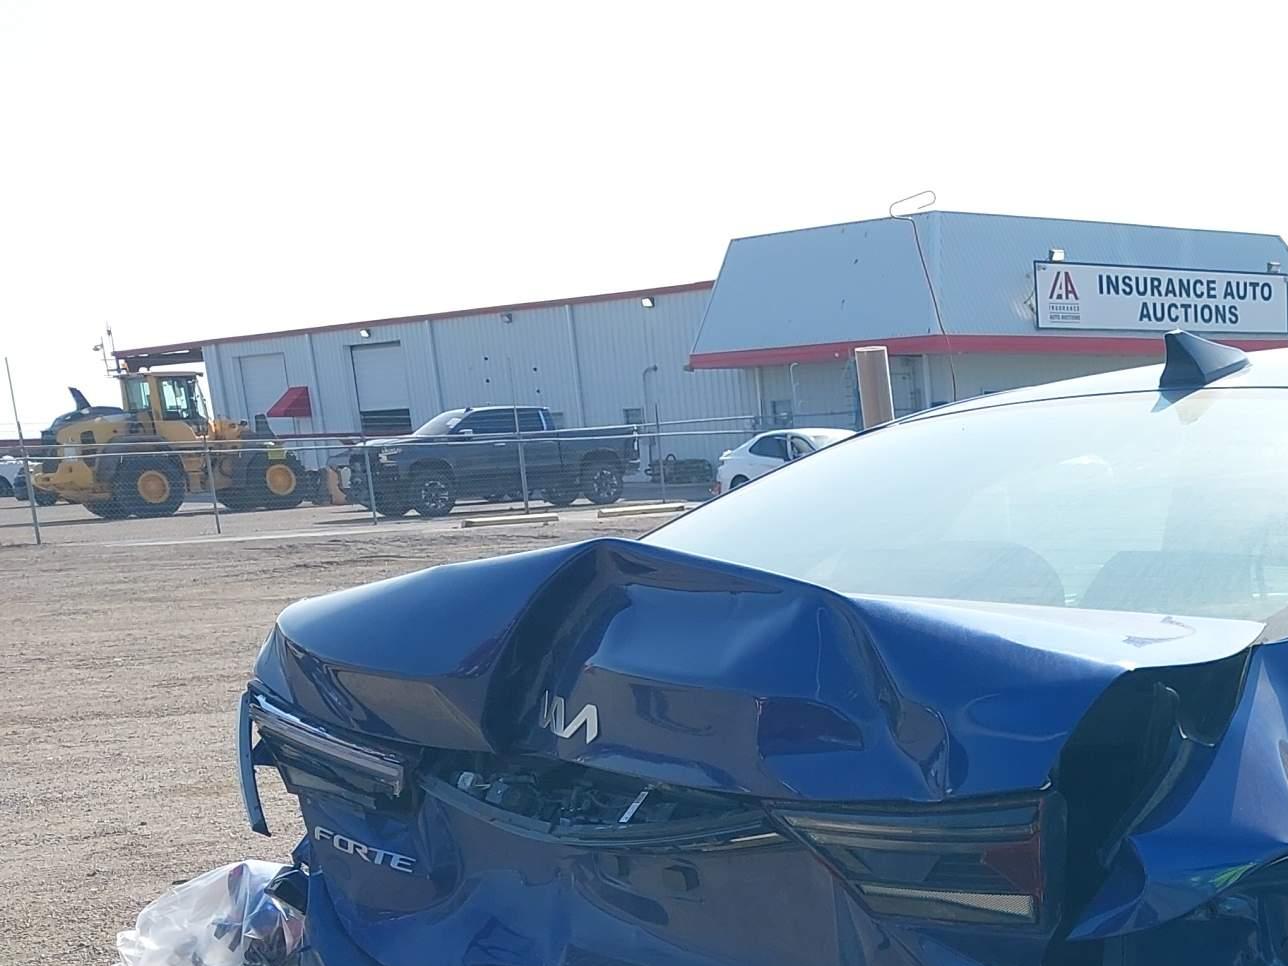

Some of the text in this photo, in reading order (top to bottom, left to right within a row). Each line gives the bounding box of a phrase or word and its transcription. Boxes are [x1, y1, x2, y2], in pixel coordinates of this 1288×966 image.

[1098, 274, 1273, 301] INSURANCE AUTO
[1139, 302, 1239, 324] AUCTIONS
[314, 825, 417, 873] FORTE
